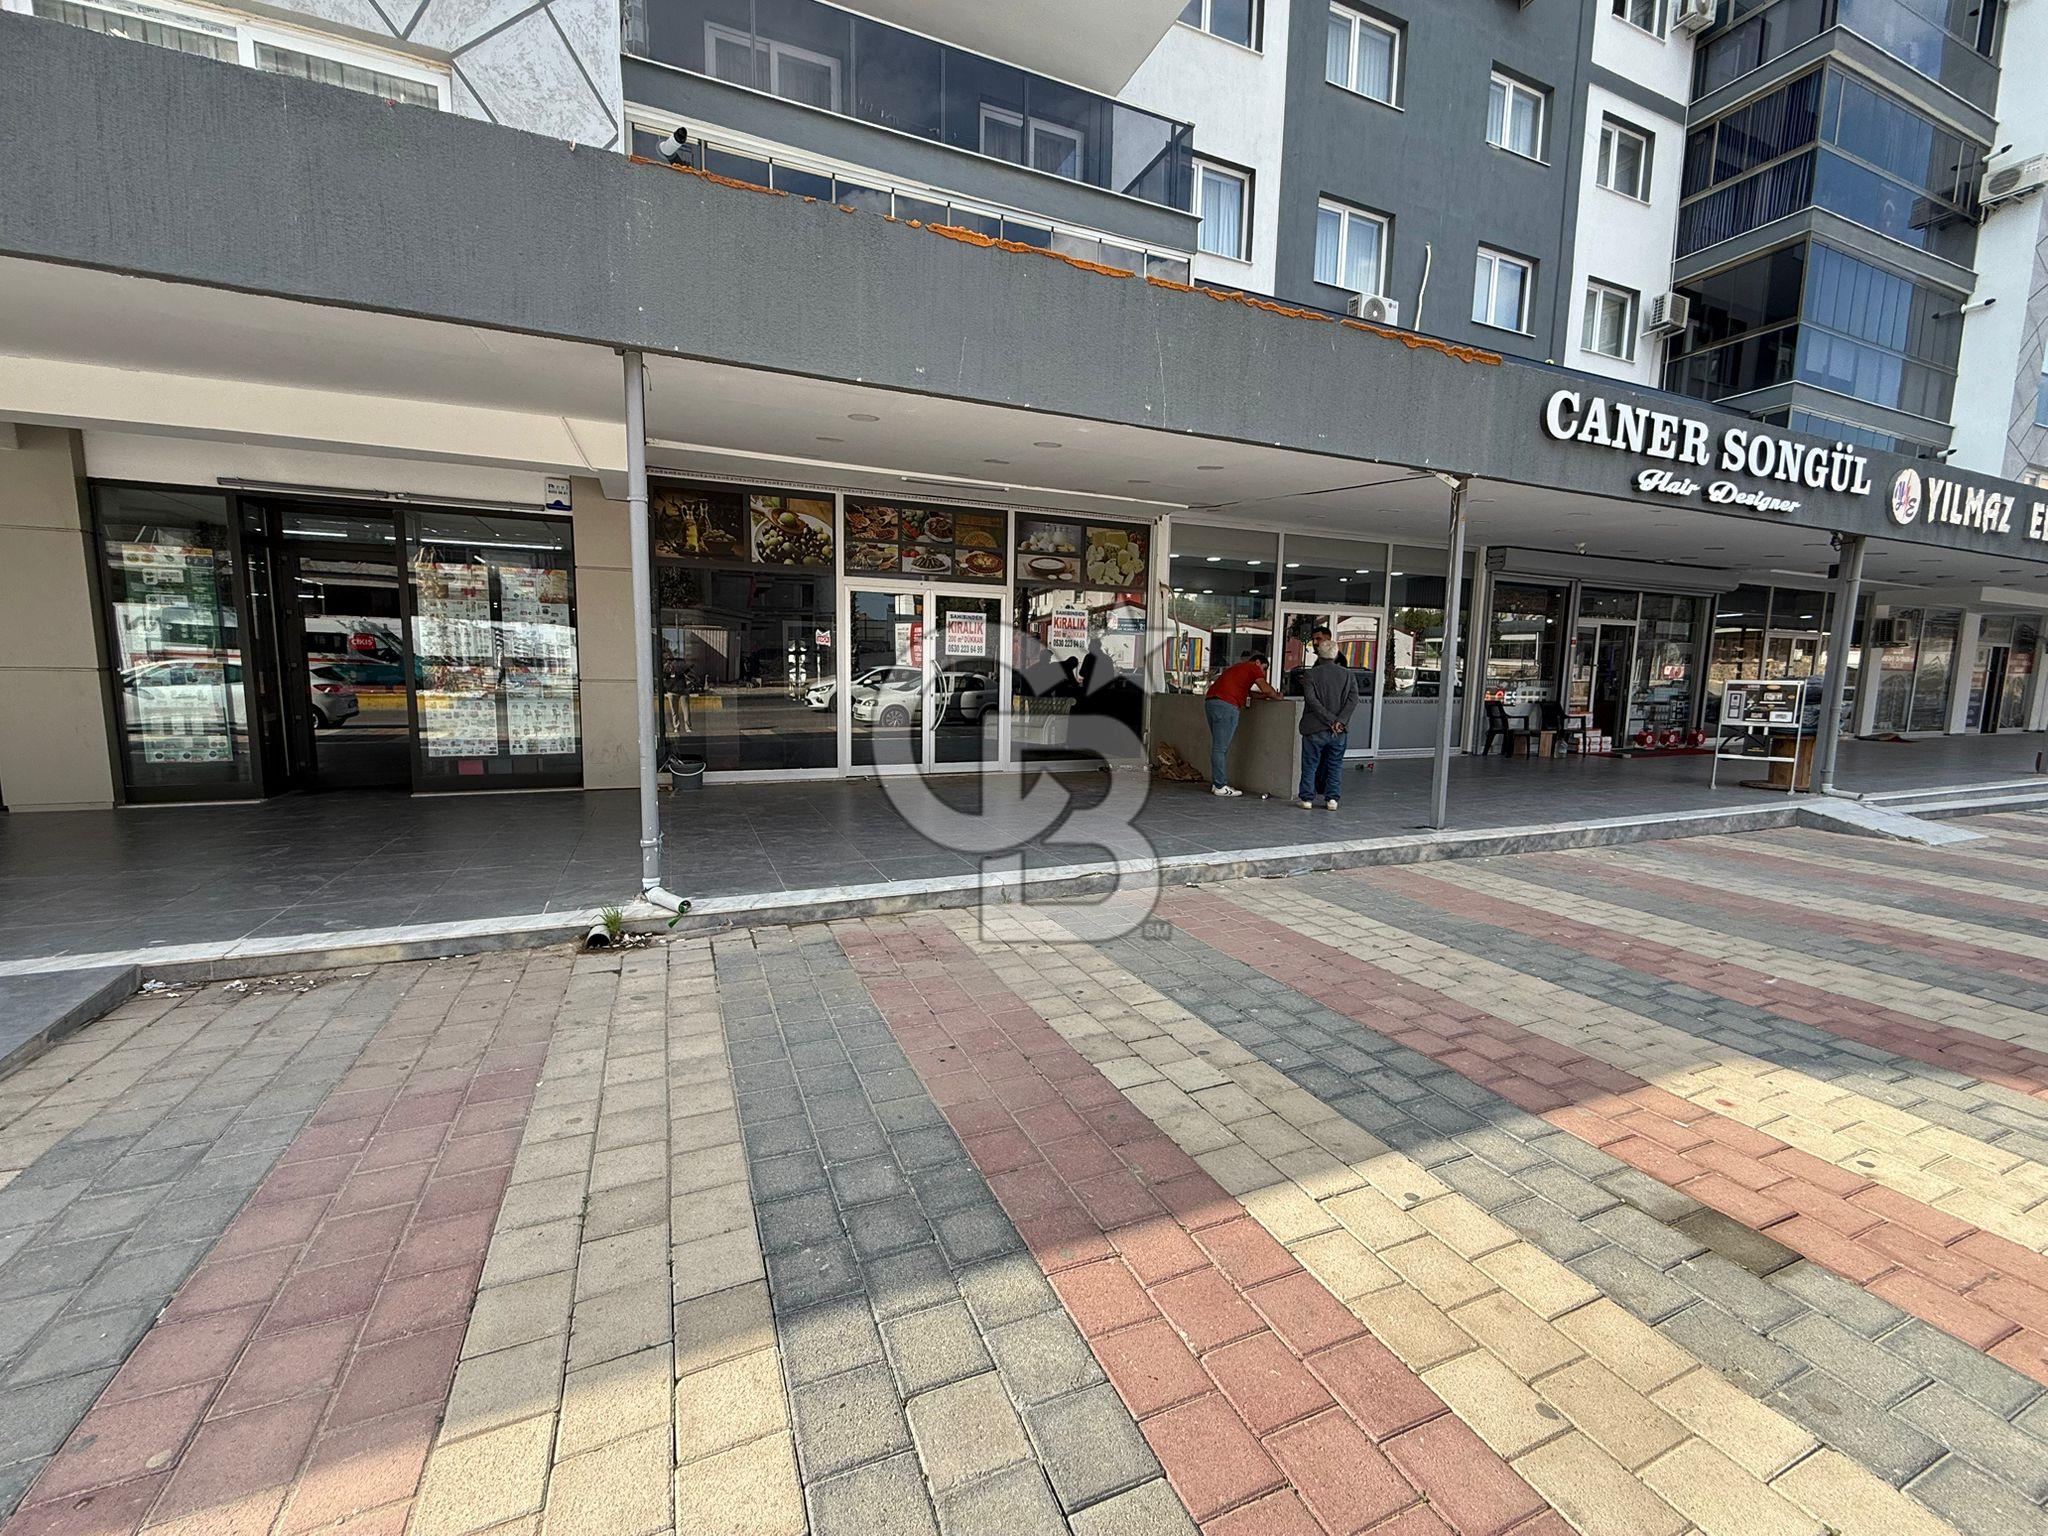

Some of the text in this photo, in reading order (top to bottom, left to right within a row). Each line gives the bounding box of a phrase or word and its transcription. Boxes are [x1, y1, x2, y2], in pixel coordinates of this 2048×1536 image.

[1546, 388, 1872, 496] CANER SONGÜL
[1637, 468, 1801, 514] Hair Designer
[1927, 477, 2015, 534] YILMAZ
